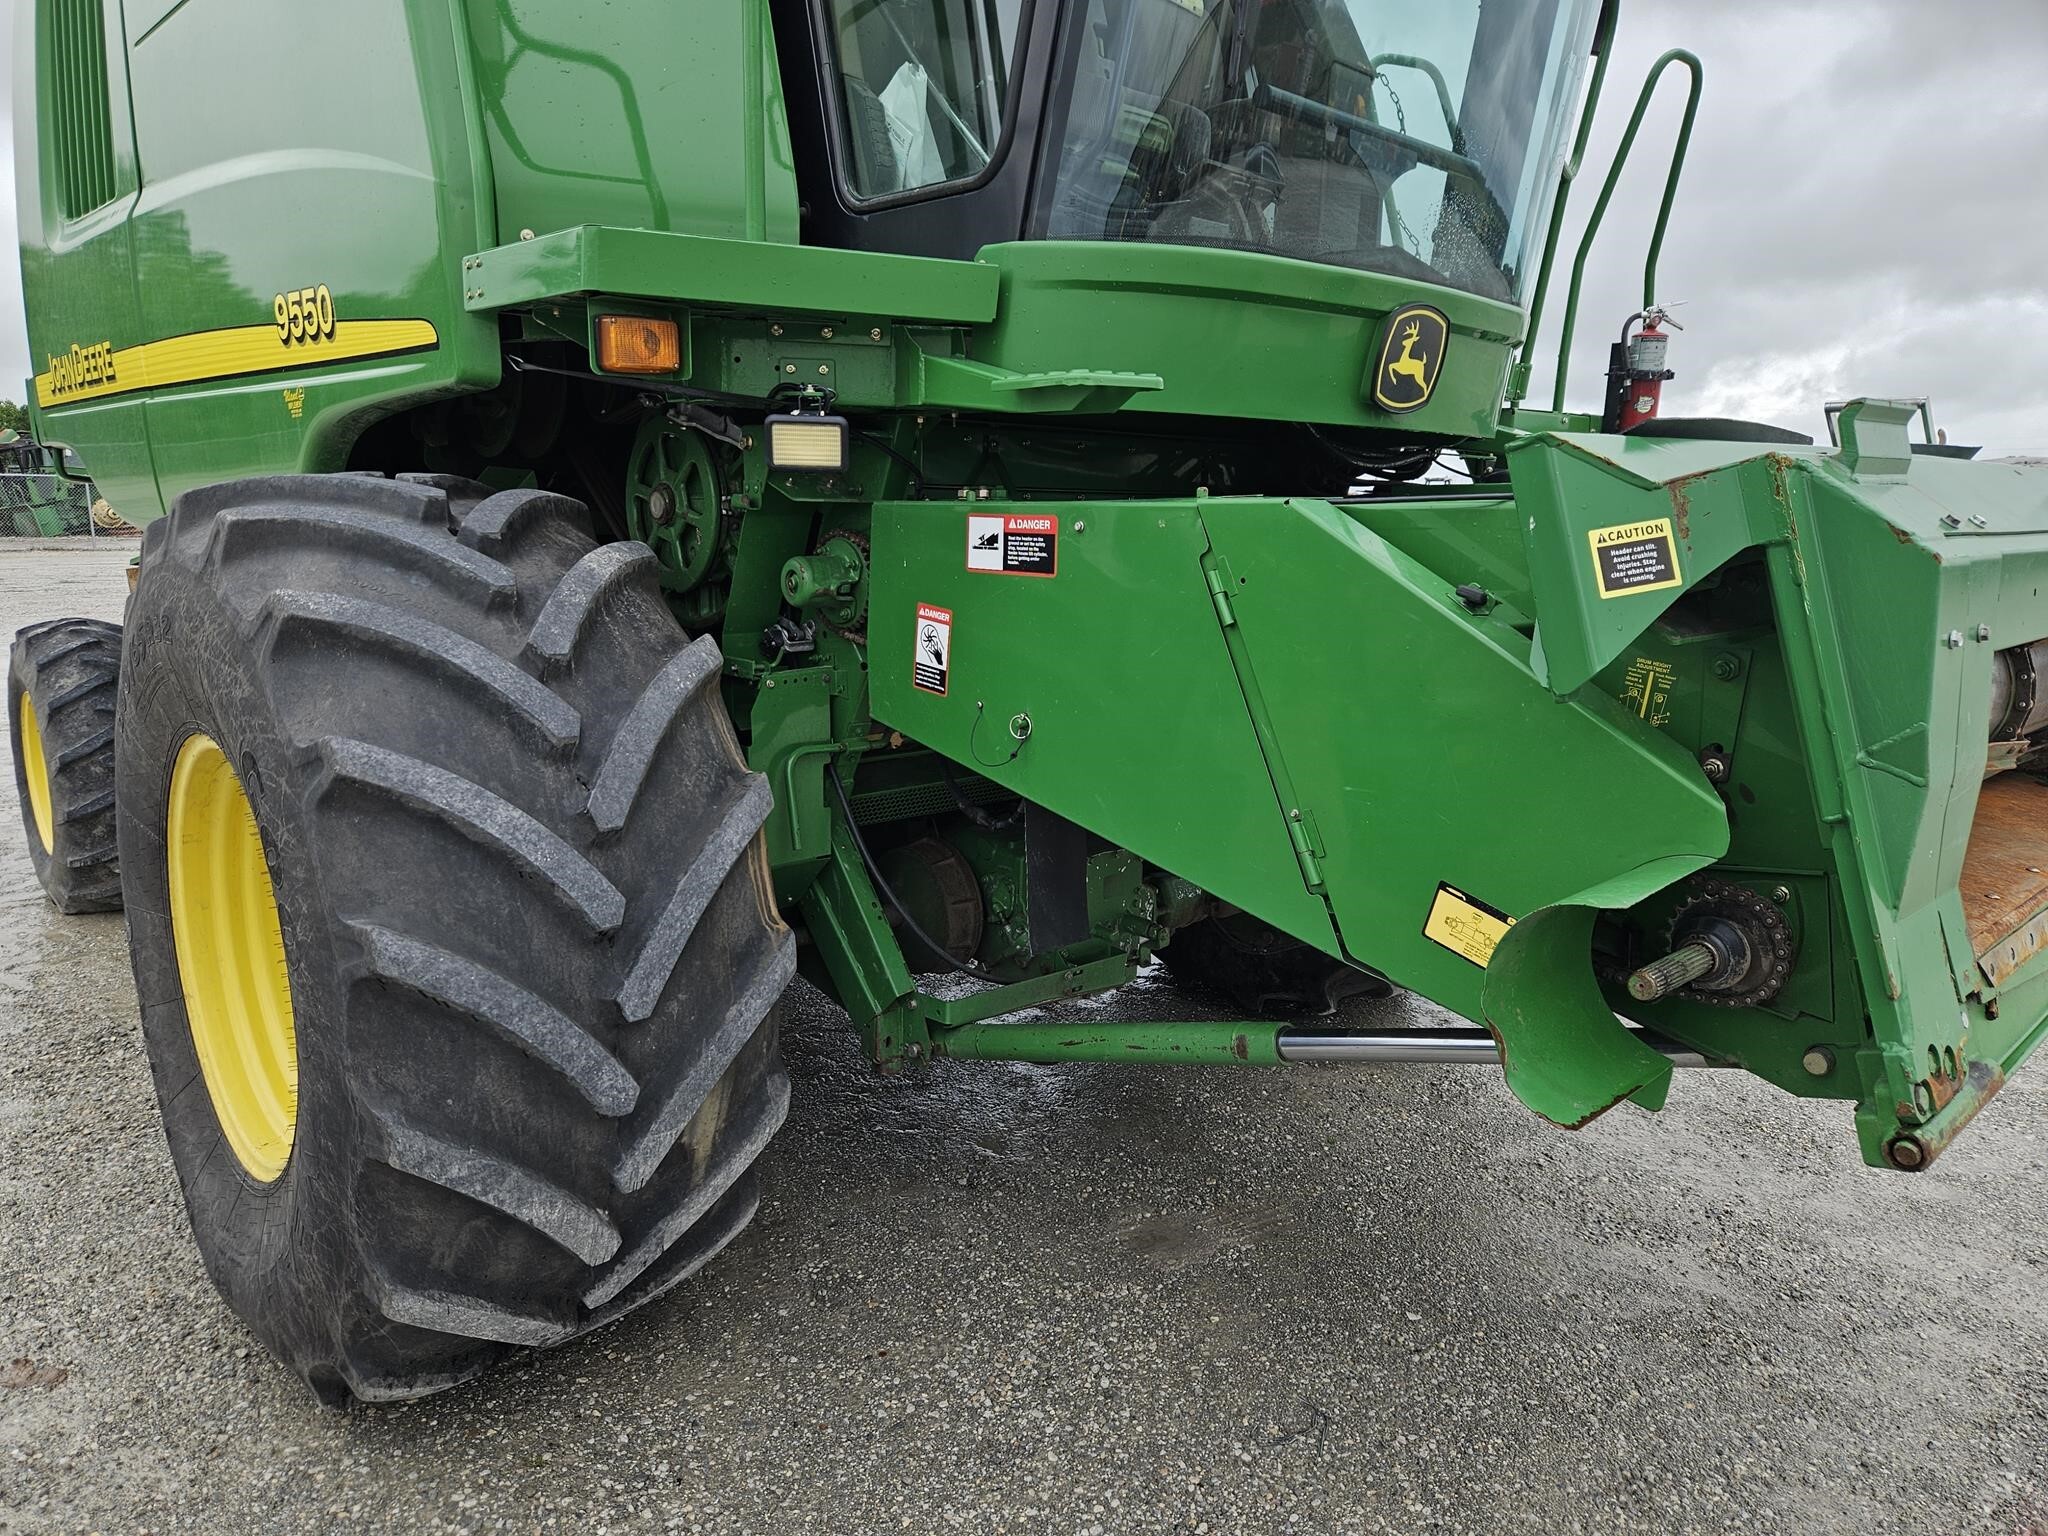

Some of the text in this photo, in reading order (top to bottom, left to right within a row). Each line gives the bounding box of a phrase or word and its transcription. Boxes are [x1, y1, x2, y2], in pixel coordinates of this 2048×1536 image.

[274, 283, 335, 343] 9550
[48, 341, 116, 390] JOHN DEERE
[1017, 520, 1051, 530] DANGER
[1608, 523, 1664, 541] CAUTION
[1611, 547, 1632, 556] Header
[1613, 551, 1657, 563] Avoid crushing
[1643, 558, 1656, 566] Stay
[1611, 570, 1626, 578] clear
[1645, 564, 1665, 572] engine
[1630, 573, 1655, 582] running.
[925, 610, 950, 622] DANGER
[1636, 662, 1670, 673] ADJUSTMENT
[1637, 657, 1672, 669] DRUM HEIGHT
